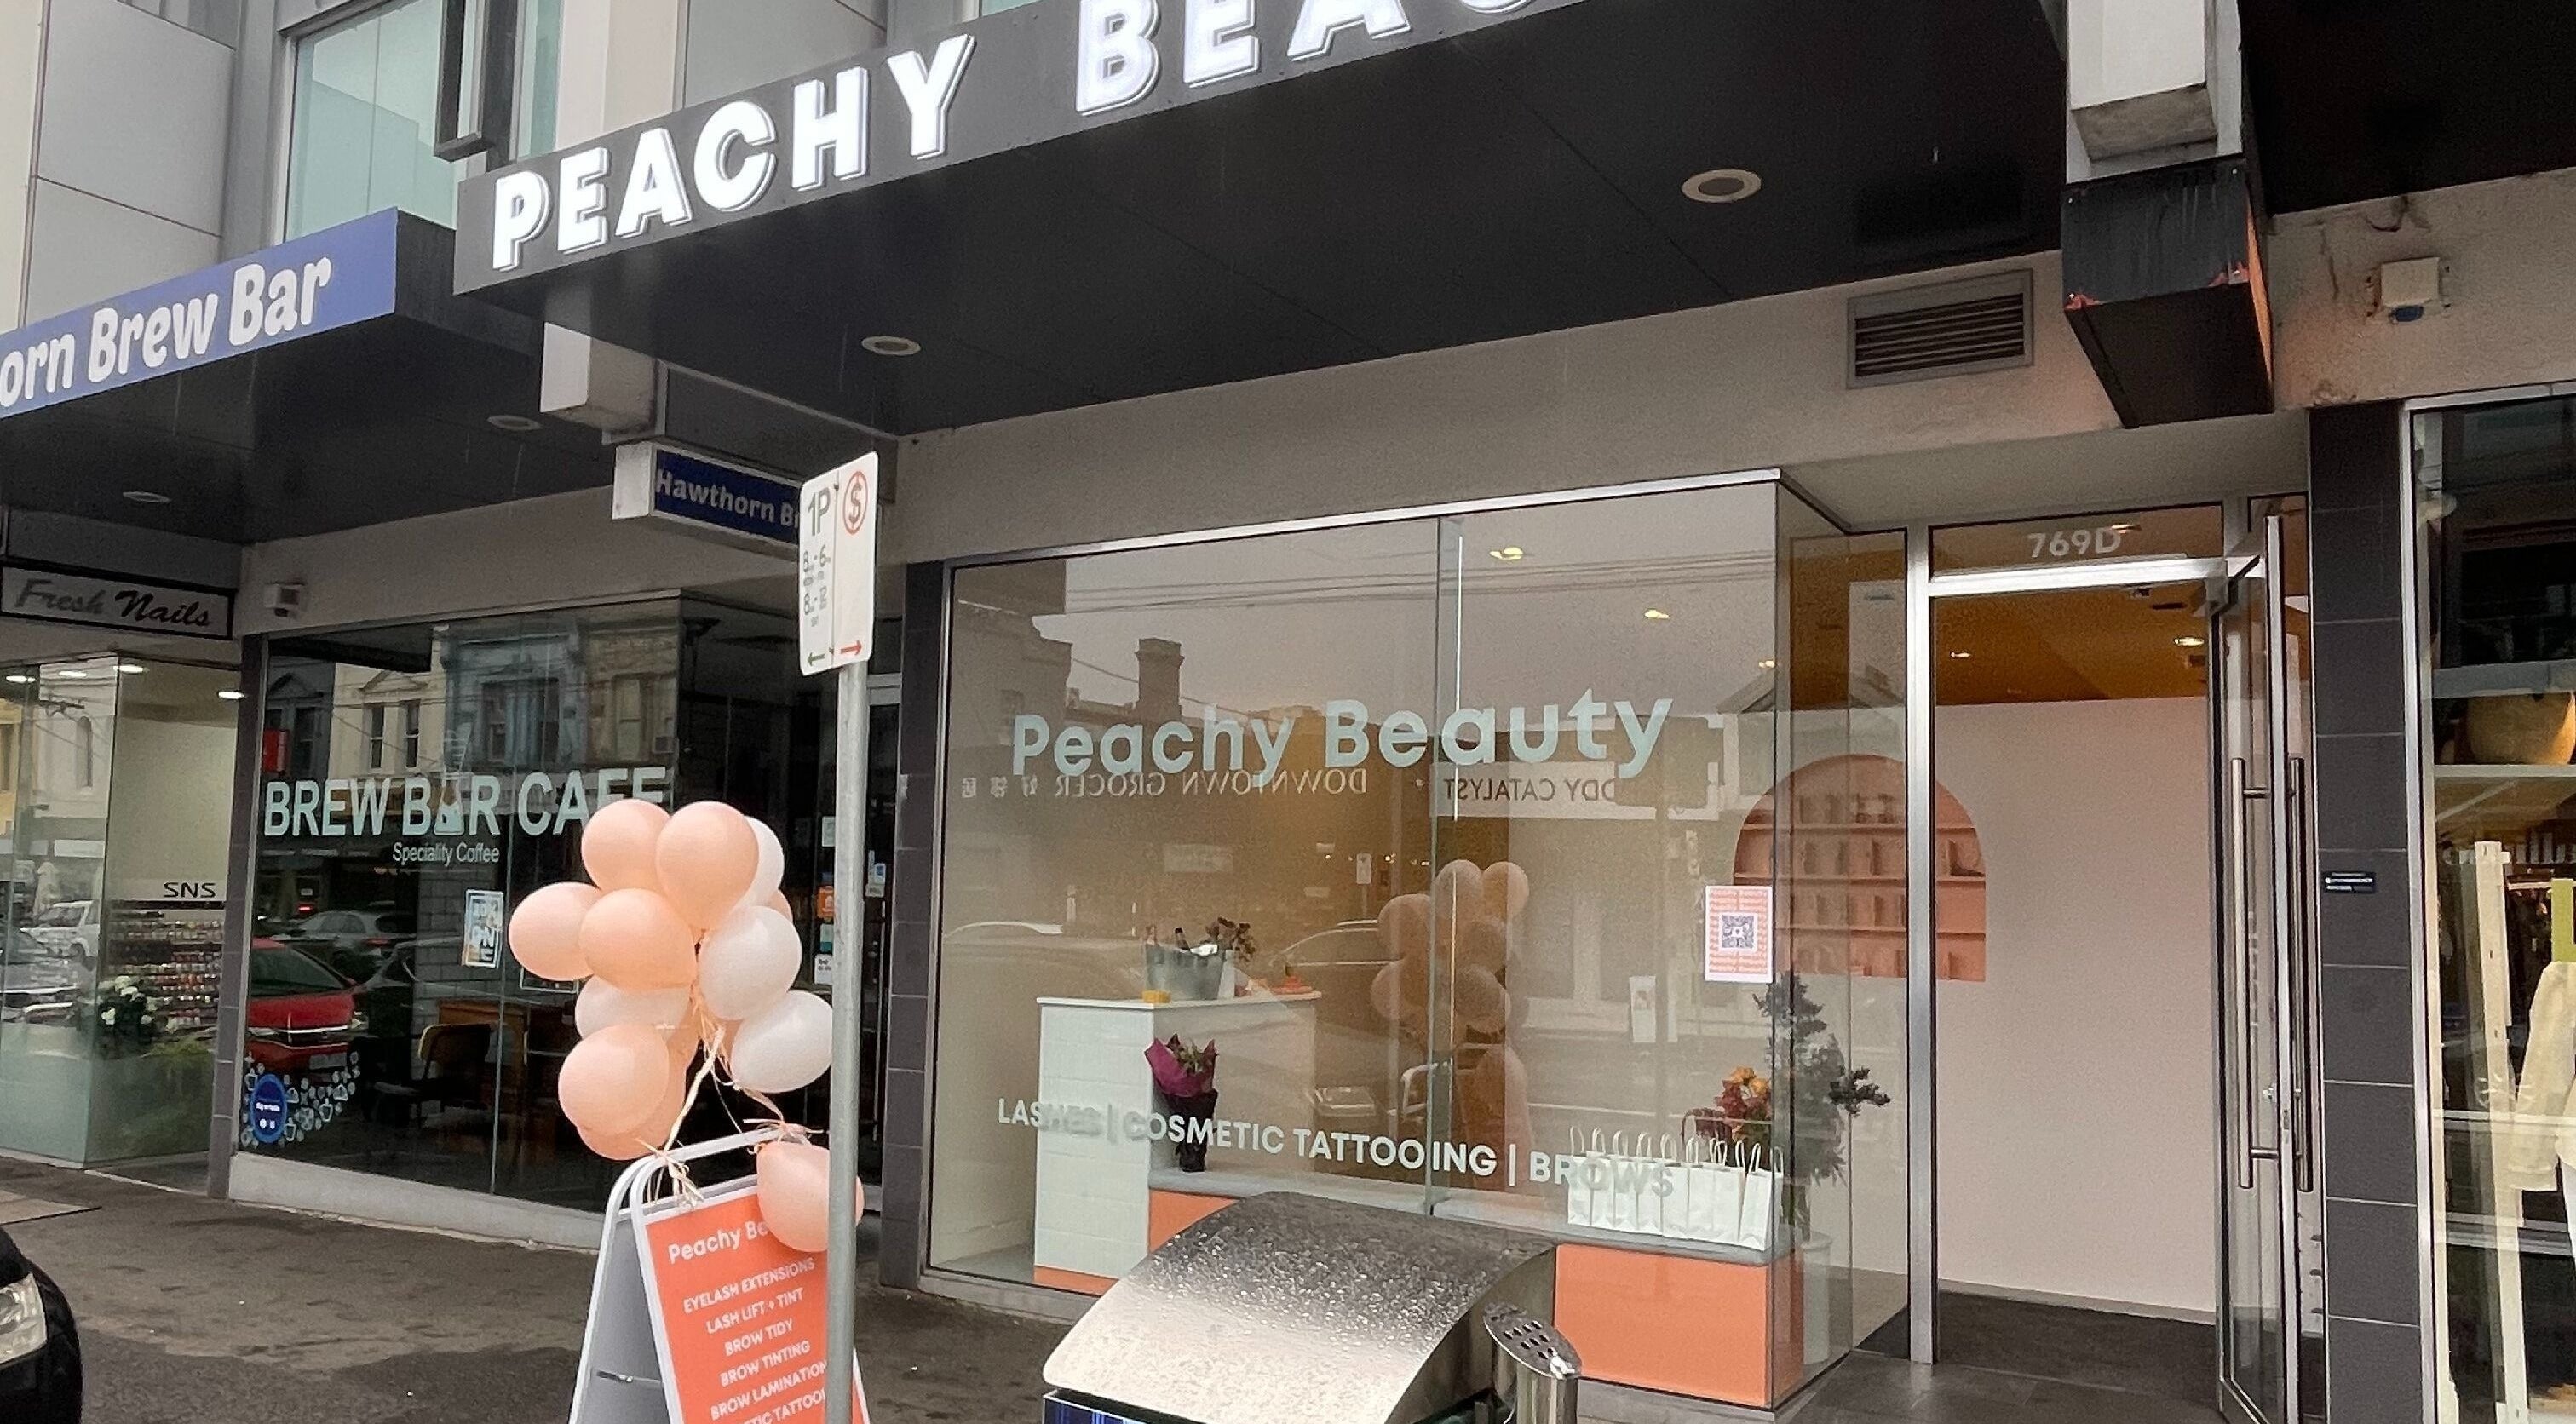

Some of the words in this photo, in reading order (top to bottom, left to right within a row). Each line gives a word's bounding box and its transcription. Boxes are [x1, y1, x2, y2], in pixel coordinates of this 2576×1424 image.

[492, 33, 977, 272] PEACHY
[1075, 0, 1533, 116] BEA
[87, 291, 220, 383] Brew
[228, 256, 332, 346] Bar
[655, 469, 775, 523] Hawthorn
[808, 486, 831, 537] 1P
[2027, 526, 2122, 559] 769D
[14, 577, 106, 614] Fresh
[114, 589, 211, 627] Nails
[1012, 703, 1294, 787] Peachy
[1325, 687, 1674, 778] Beauty
[263, 777, 392, 837] BREW
[401, 773, 501, 837] BAR
[392, 841, 453, 868] Speciality
[457, 841, 501, 864] Coffee
[163, 881, 216, 899] SNS
[1122, 1111, 1285, 1155] COSMETIC
[1292, 1128, 1498, 1177] TATTOOING
[1529, 1151, 1675, 1198] BROWS
[668, 1227, 741, 1265] Peachy
[683, 1283, 739, 1314] EYELASH
[741, 1256, 816, 1293] EXTENSIONS
[706, 1308, 739, 1335] LASH
[740, 1300, 767, 1320] LIFT
[776, 1287, 805, 1309] TINT
[725, 1332, 764, 1357] BROW
[765, 1318, 794, 1344] TIDY
[719, 1360, 760, 1387] BROW
[761, 1339, 811, 1369] TINTING
[710, 1391, 751, 1421] BROW
